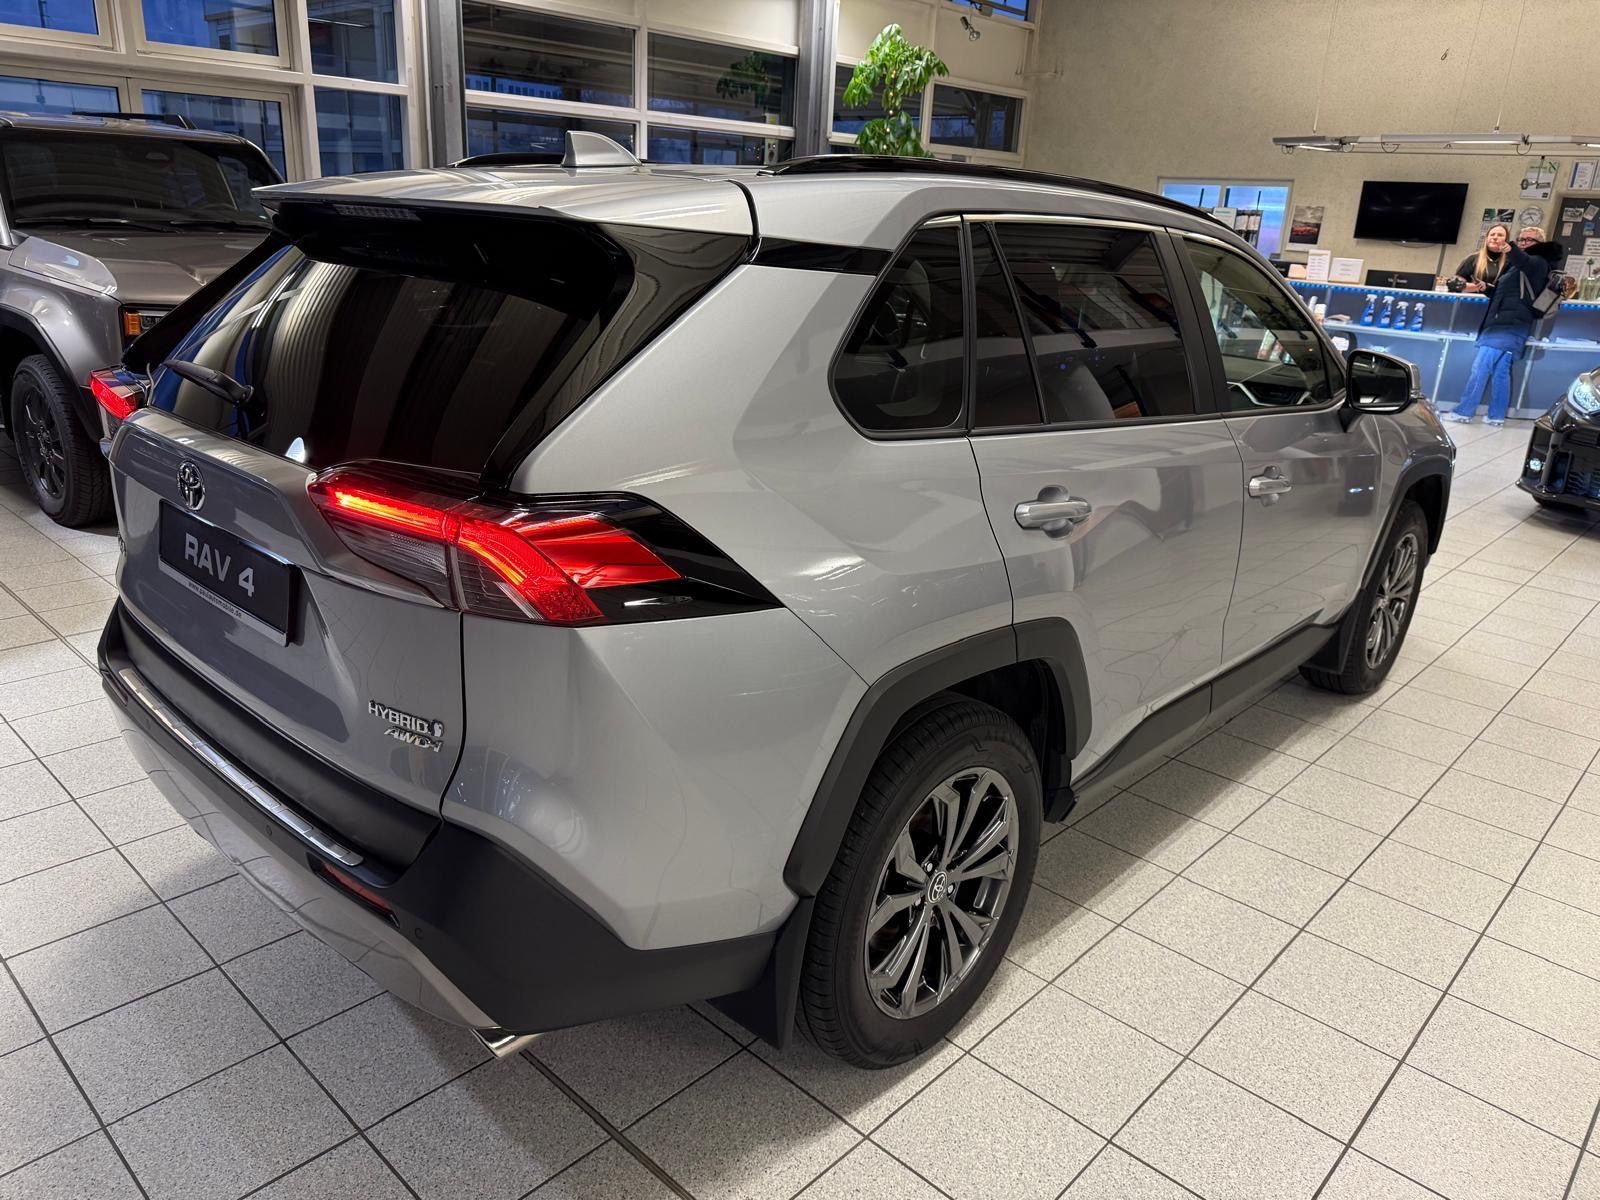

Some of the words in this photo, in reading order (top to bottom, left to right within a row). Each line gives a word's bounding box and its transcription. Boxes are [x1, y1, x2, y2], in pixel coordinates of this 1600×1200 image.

[185, 533, 231, 582] RAV
[238, 567, 255, 597] 4
[368, 700, 430, 734] HYBRID
